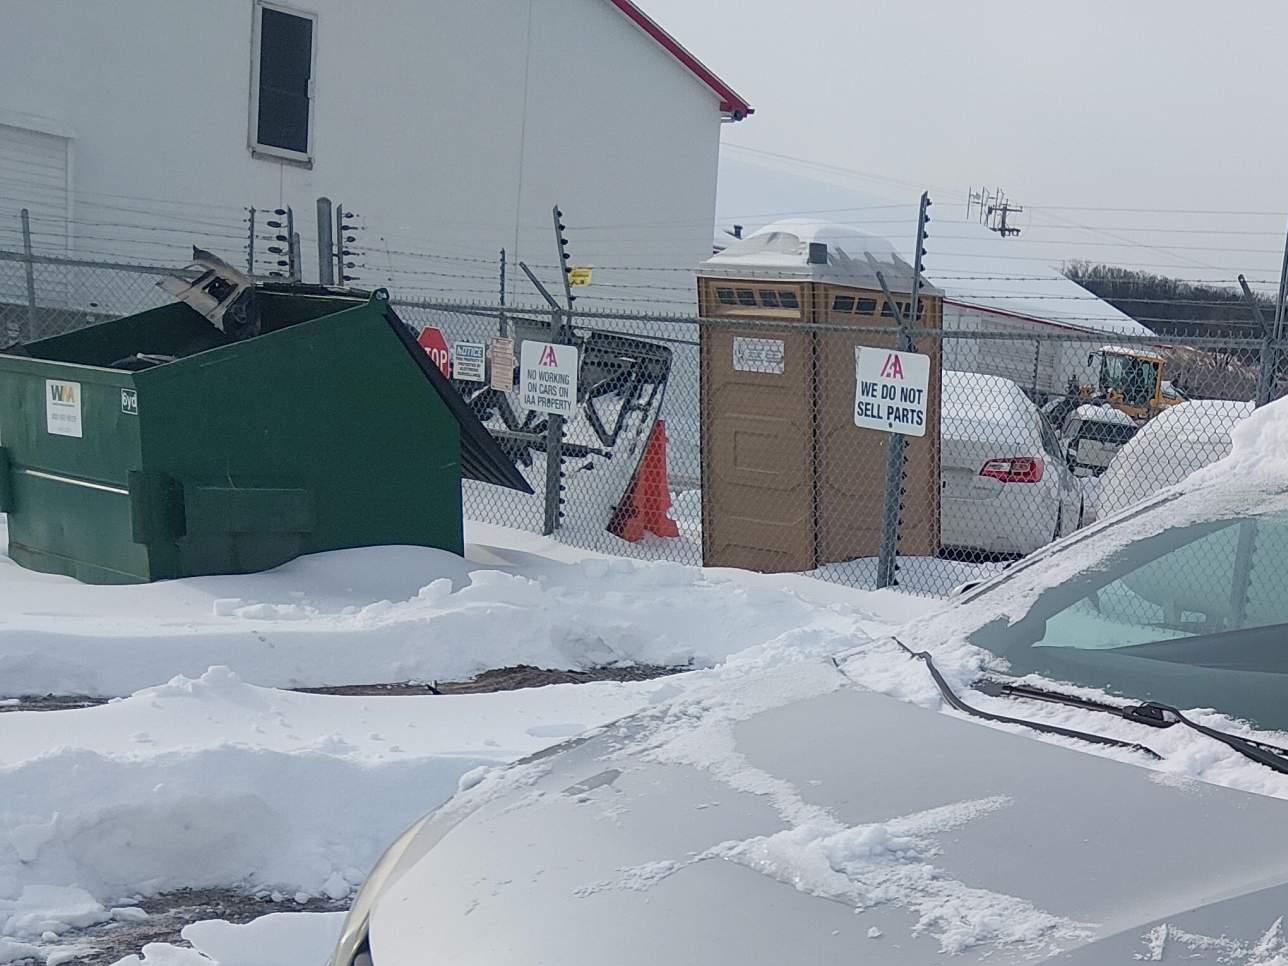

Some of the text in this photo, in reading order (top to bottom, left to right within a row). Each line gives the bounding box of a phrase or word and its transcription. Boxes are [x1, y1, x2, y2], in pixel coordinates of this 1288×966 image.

[424, 347, 447, 372] TOP
[456, 346, 482, 358] NOTICE
[527, 369, 570, 385] NO WORKING
[527, 382, 569, 398] ON CARS ON
[861, 381, 923, 404] WE DO NOT
[524, 394, 571, 411] IAA PROPERTY
[857, 401, 924, 426] SELL PARTS
